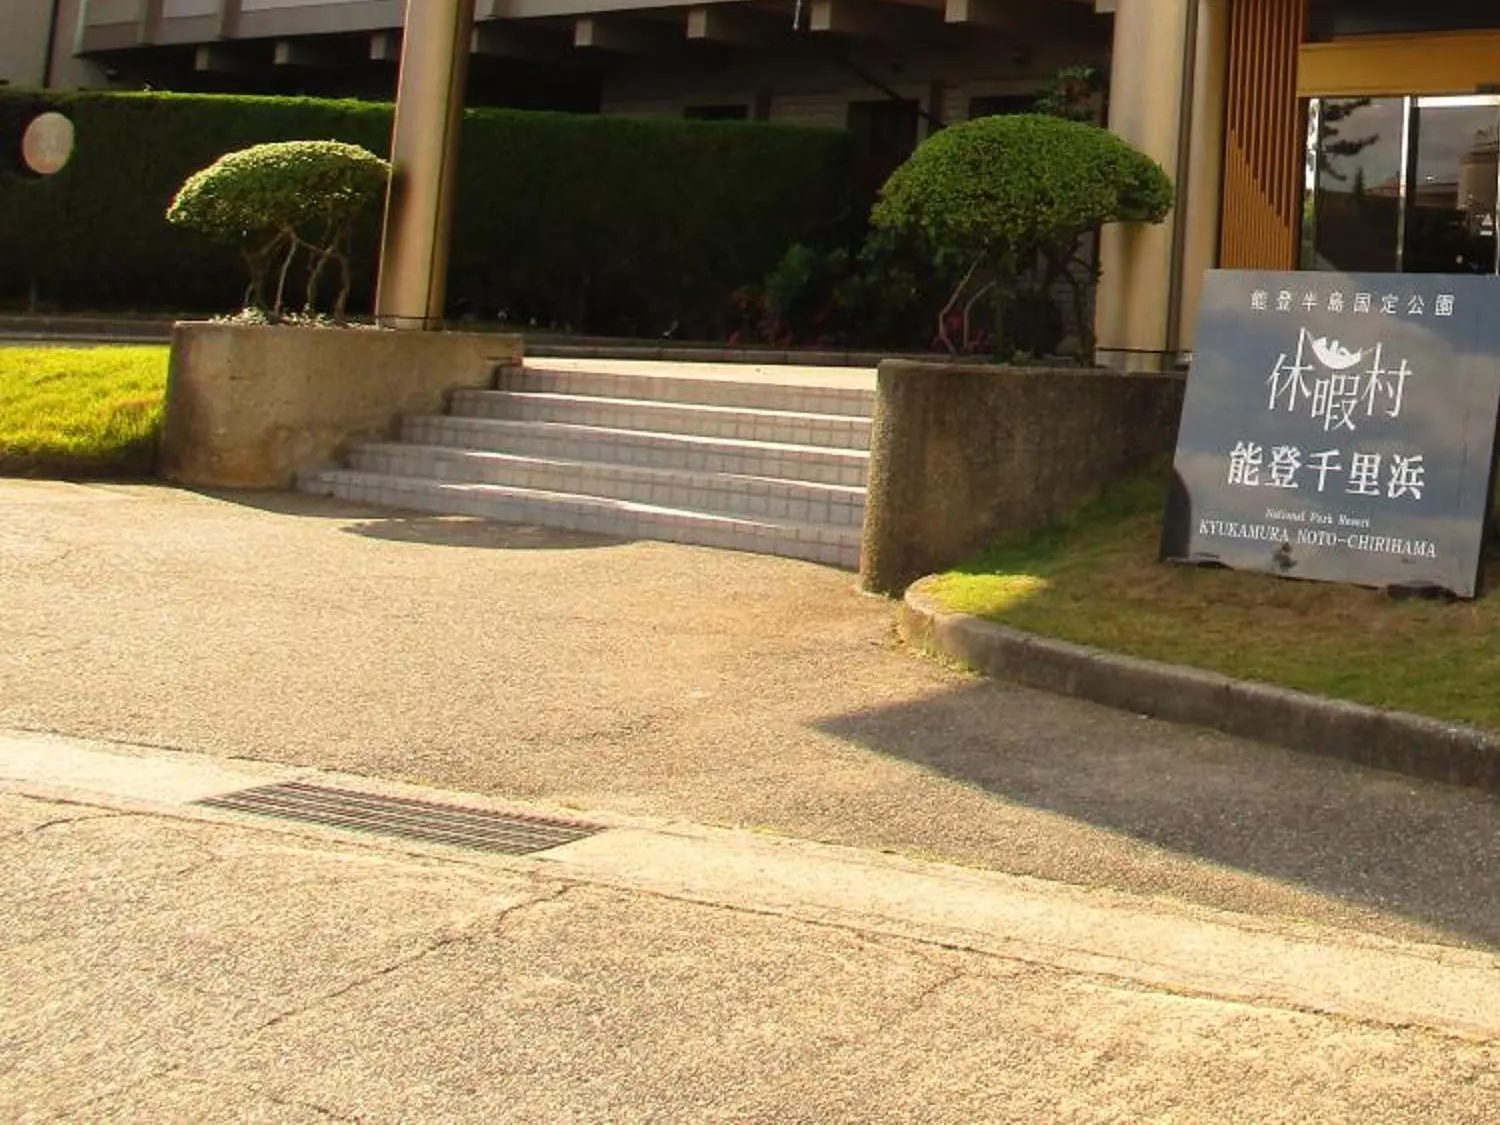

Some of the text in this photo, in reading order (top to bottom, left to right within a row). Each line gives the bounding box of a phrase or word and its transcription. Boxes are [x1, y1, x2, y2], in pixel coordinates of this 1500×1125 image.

[1251, 290, 1455, 316] 能登半島国定公園
[1267, 327, 1412, 431] 休暇村
[1227, 441, 1425, 500] 能登千里浜
[1265, 507, 1306, 523] National
[1309, 511, 1333, 525] Park
[1199, 518, 1289, 543] KYUKAMURA
